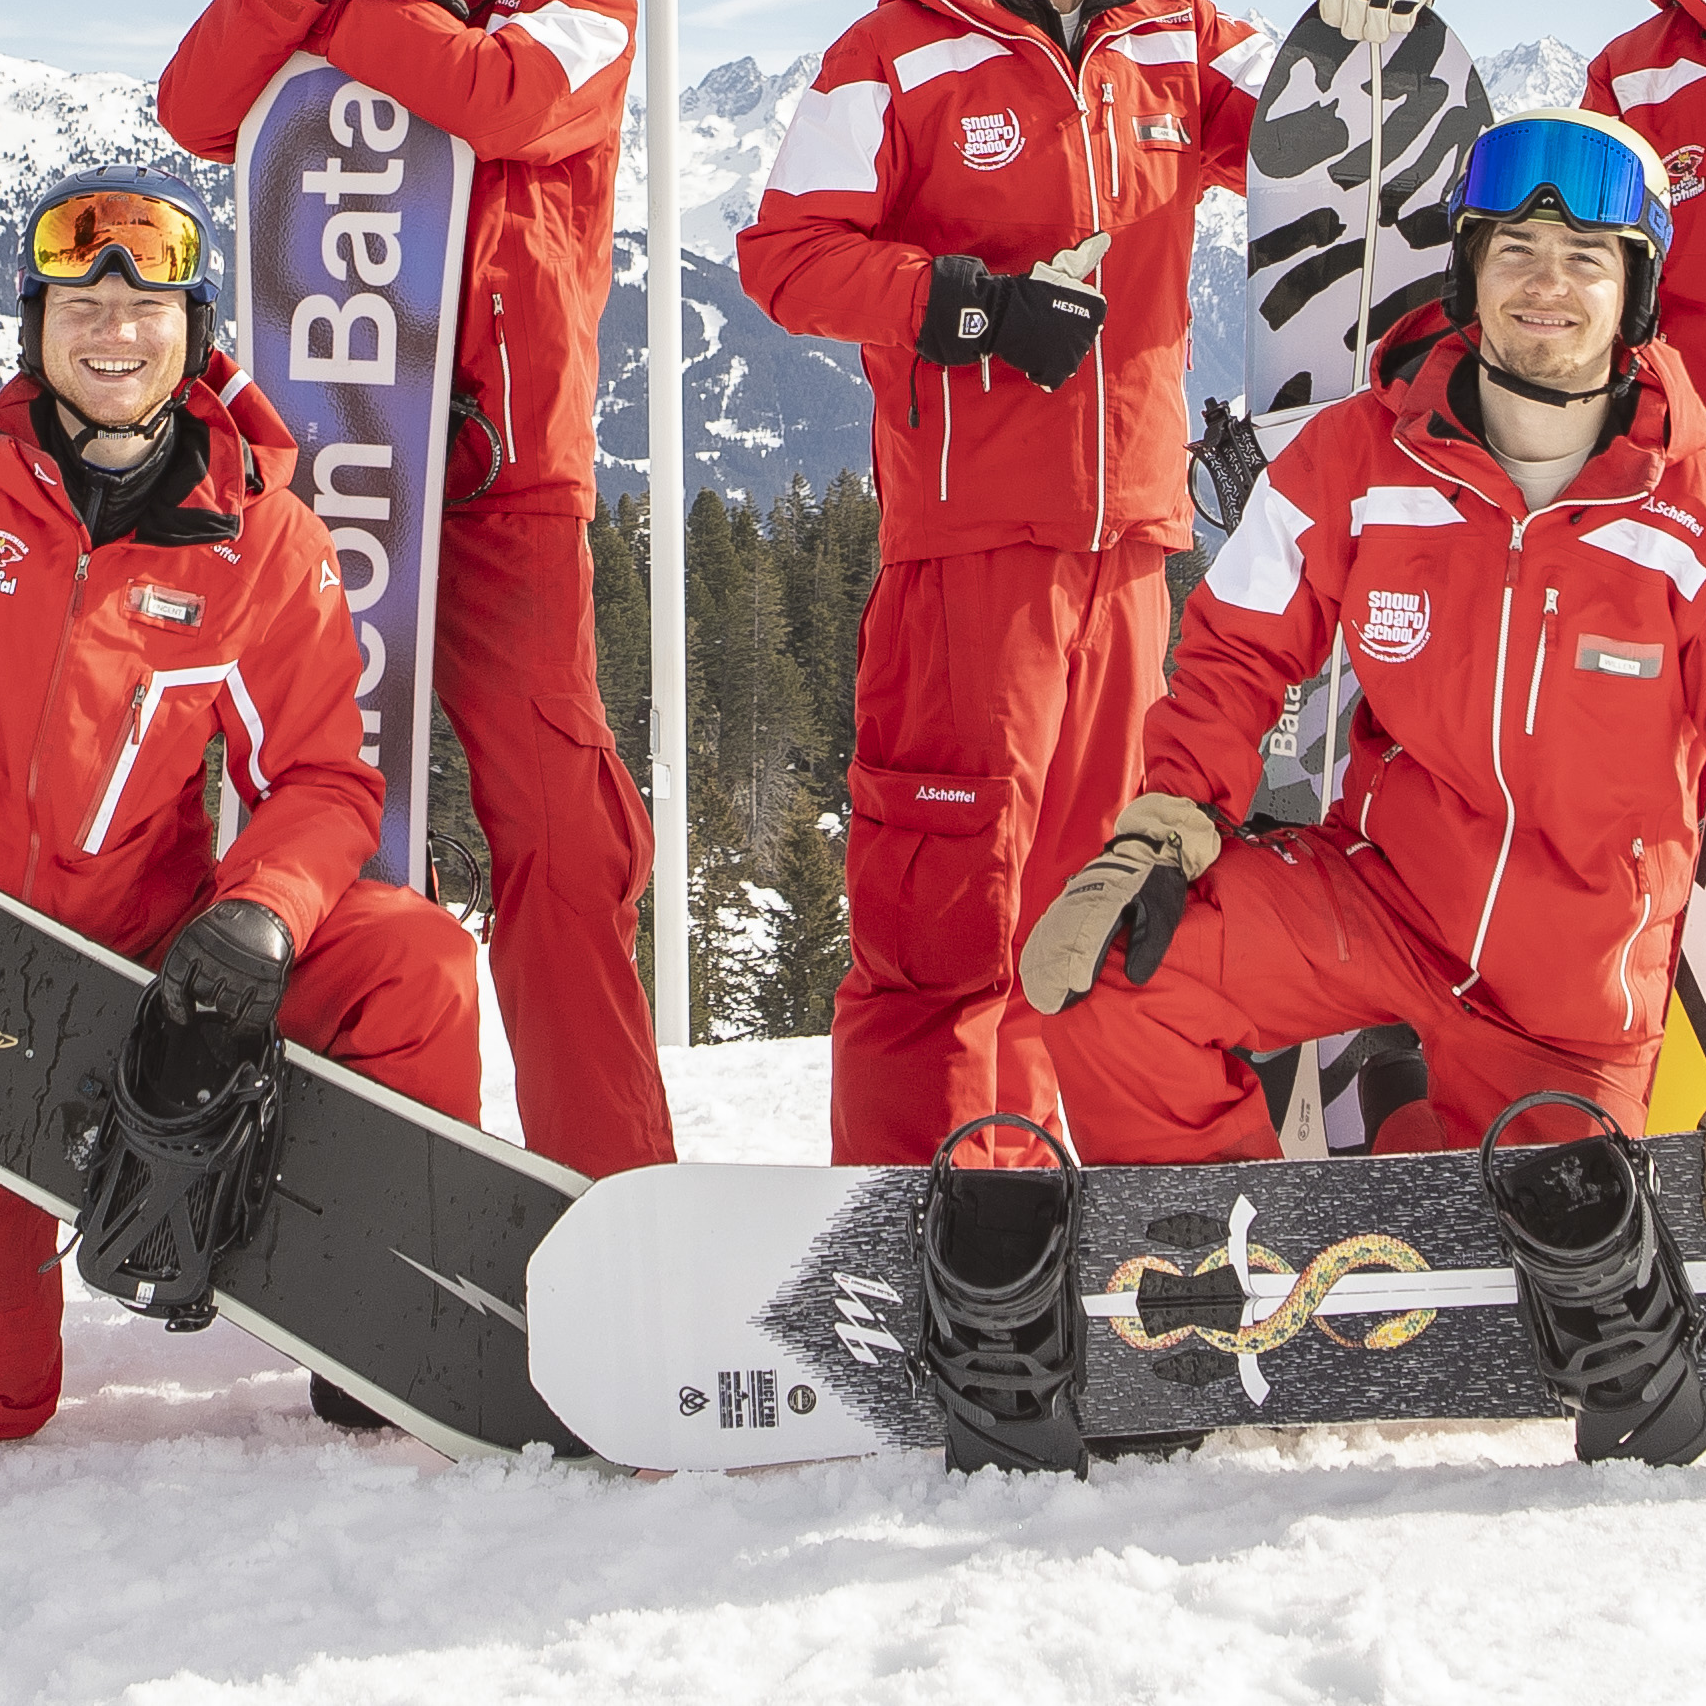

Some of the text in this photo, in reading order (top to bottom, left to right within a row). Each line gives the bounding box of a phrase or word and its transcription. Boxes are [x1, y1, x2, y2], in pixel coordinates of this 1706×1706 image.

[1052, 298, 1091, 320] HESTRA
[927, 787, 976, 803] Schöffel
[762, 1369, 776, 1428] T.RICE PRO
